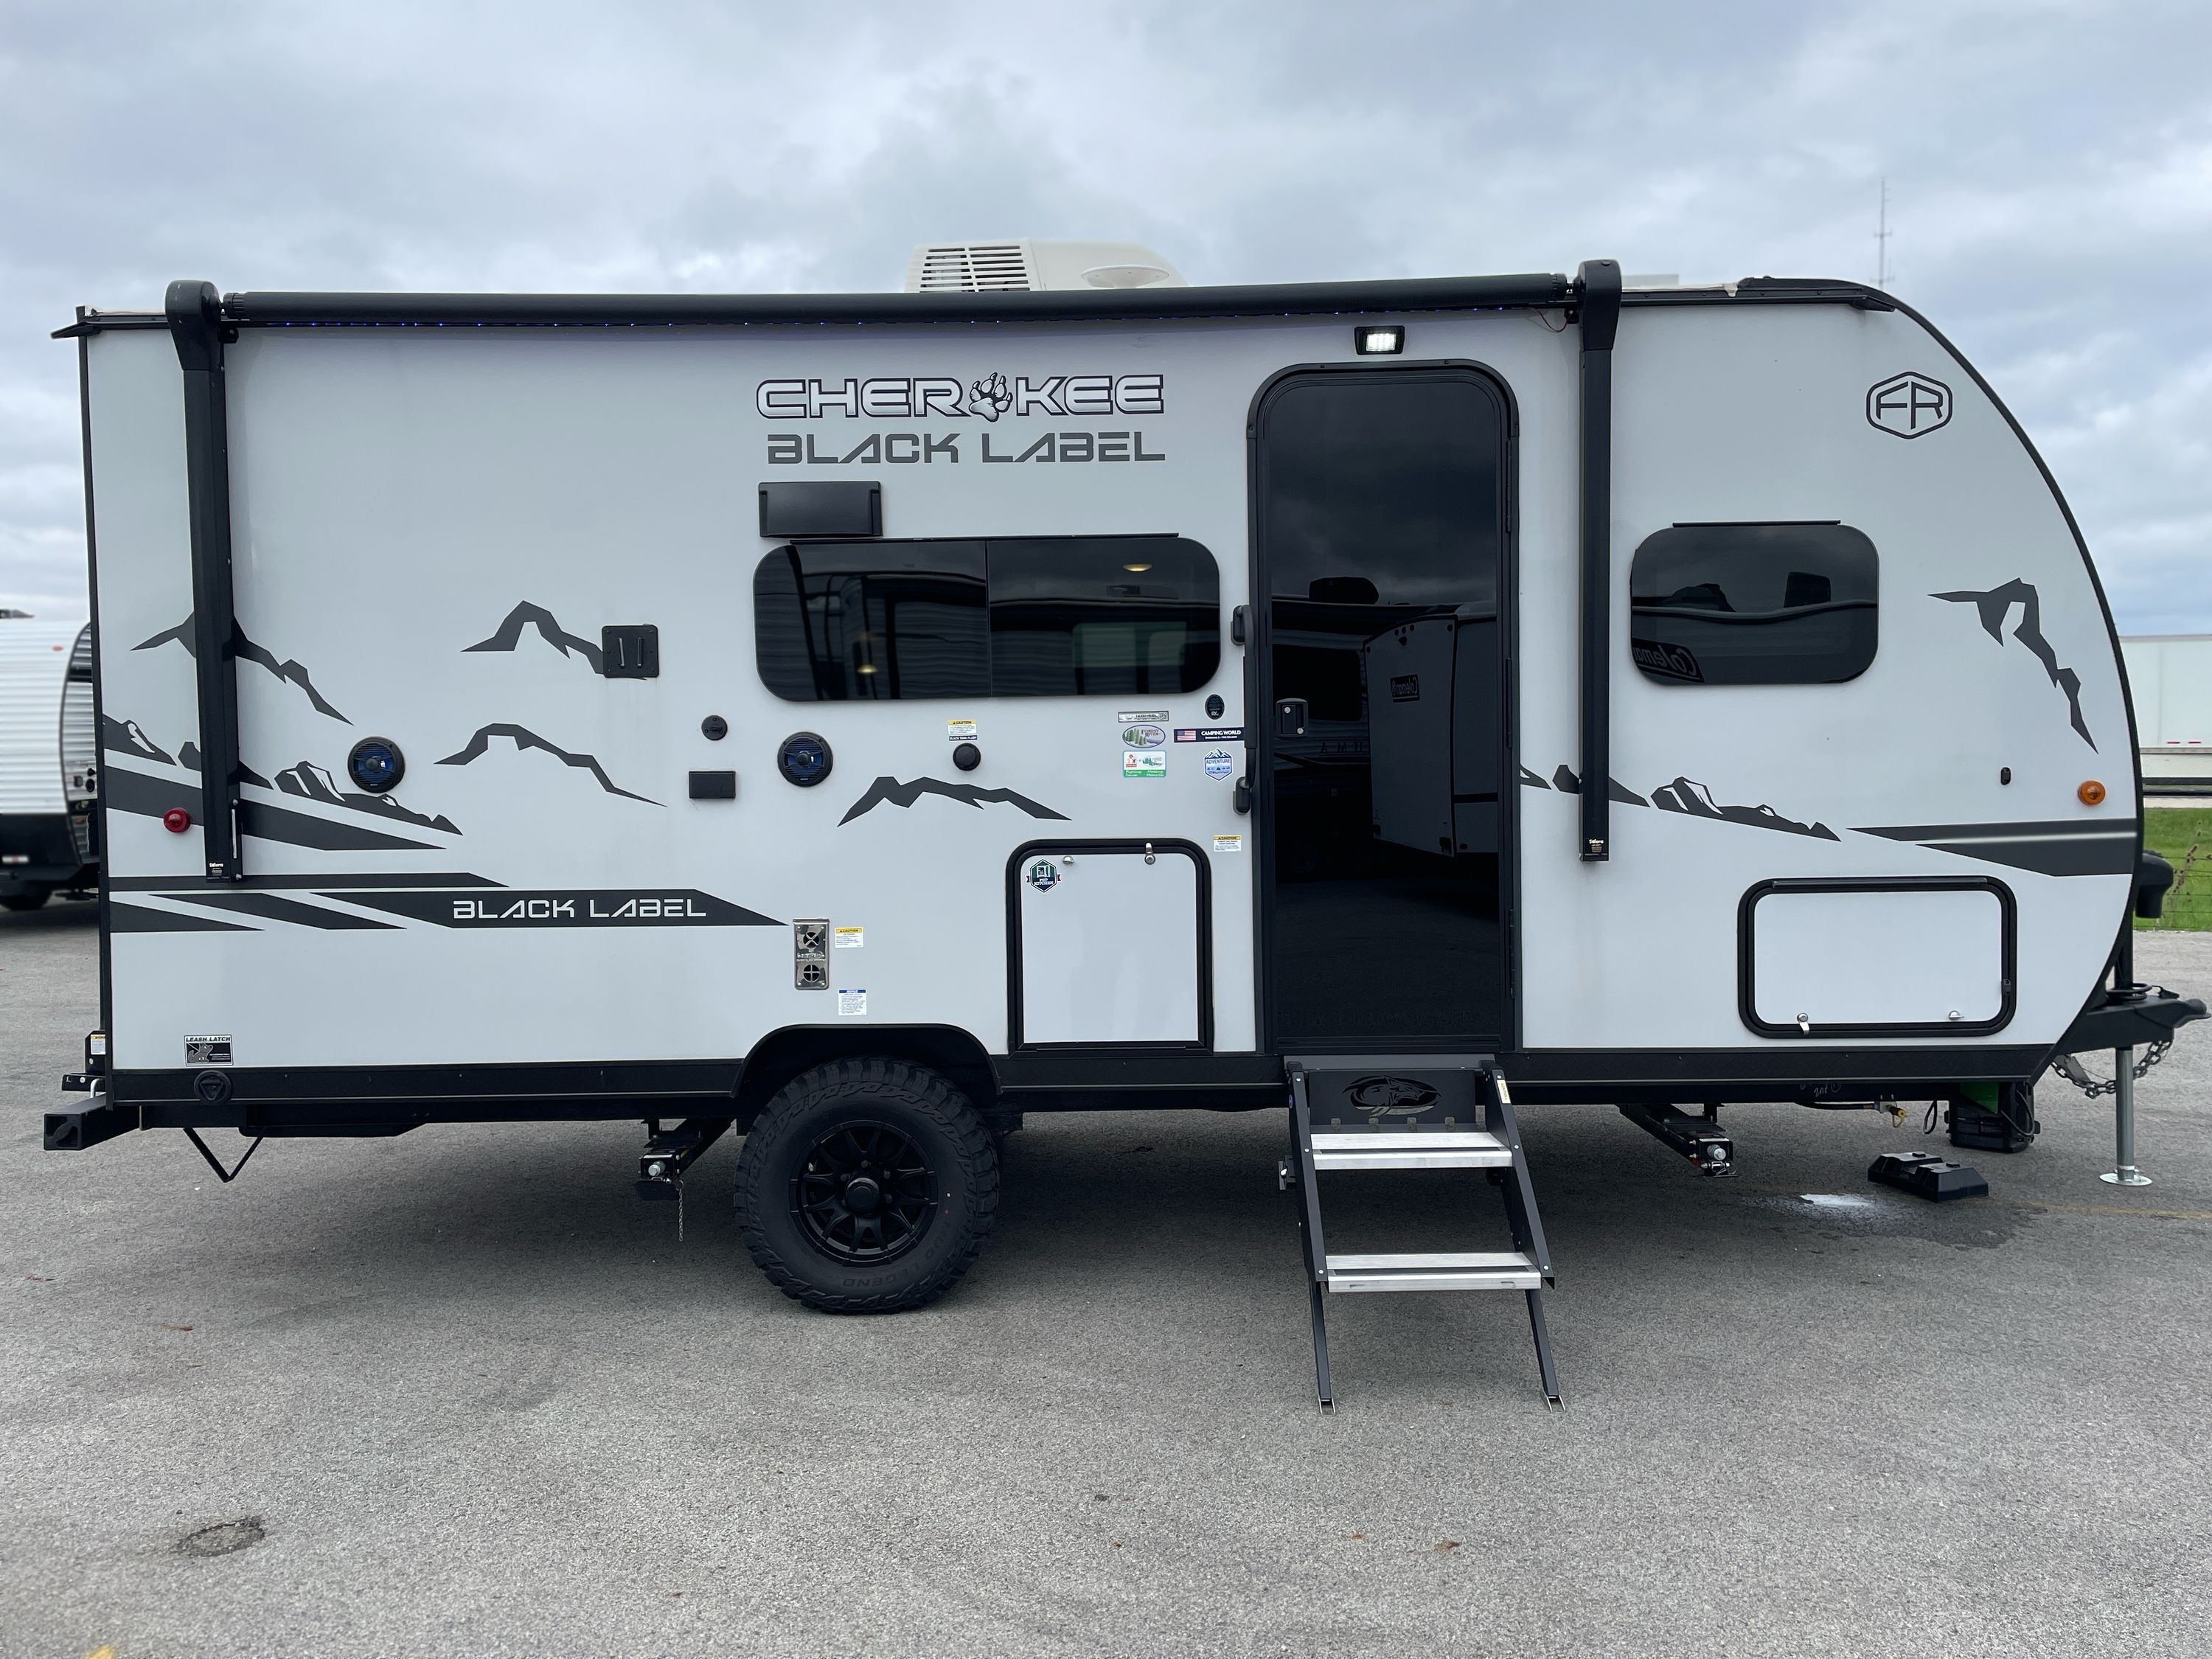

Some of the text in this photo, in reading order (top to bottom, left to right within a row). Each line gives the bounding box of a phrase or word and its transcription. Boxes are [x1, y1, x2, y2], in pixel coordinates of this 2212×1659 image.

[767, 431, 1166, 464] BLACK LABEL
[453, 898, 706, 919] BLACK LABEL
